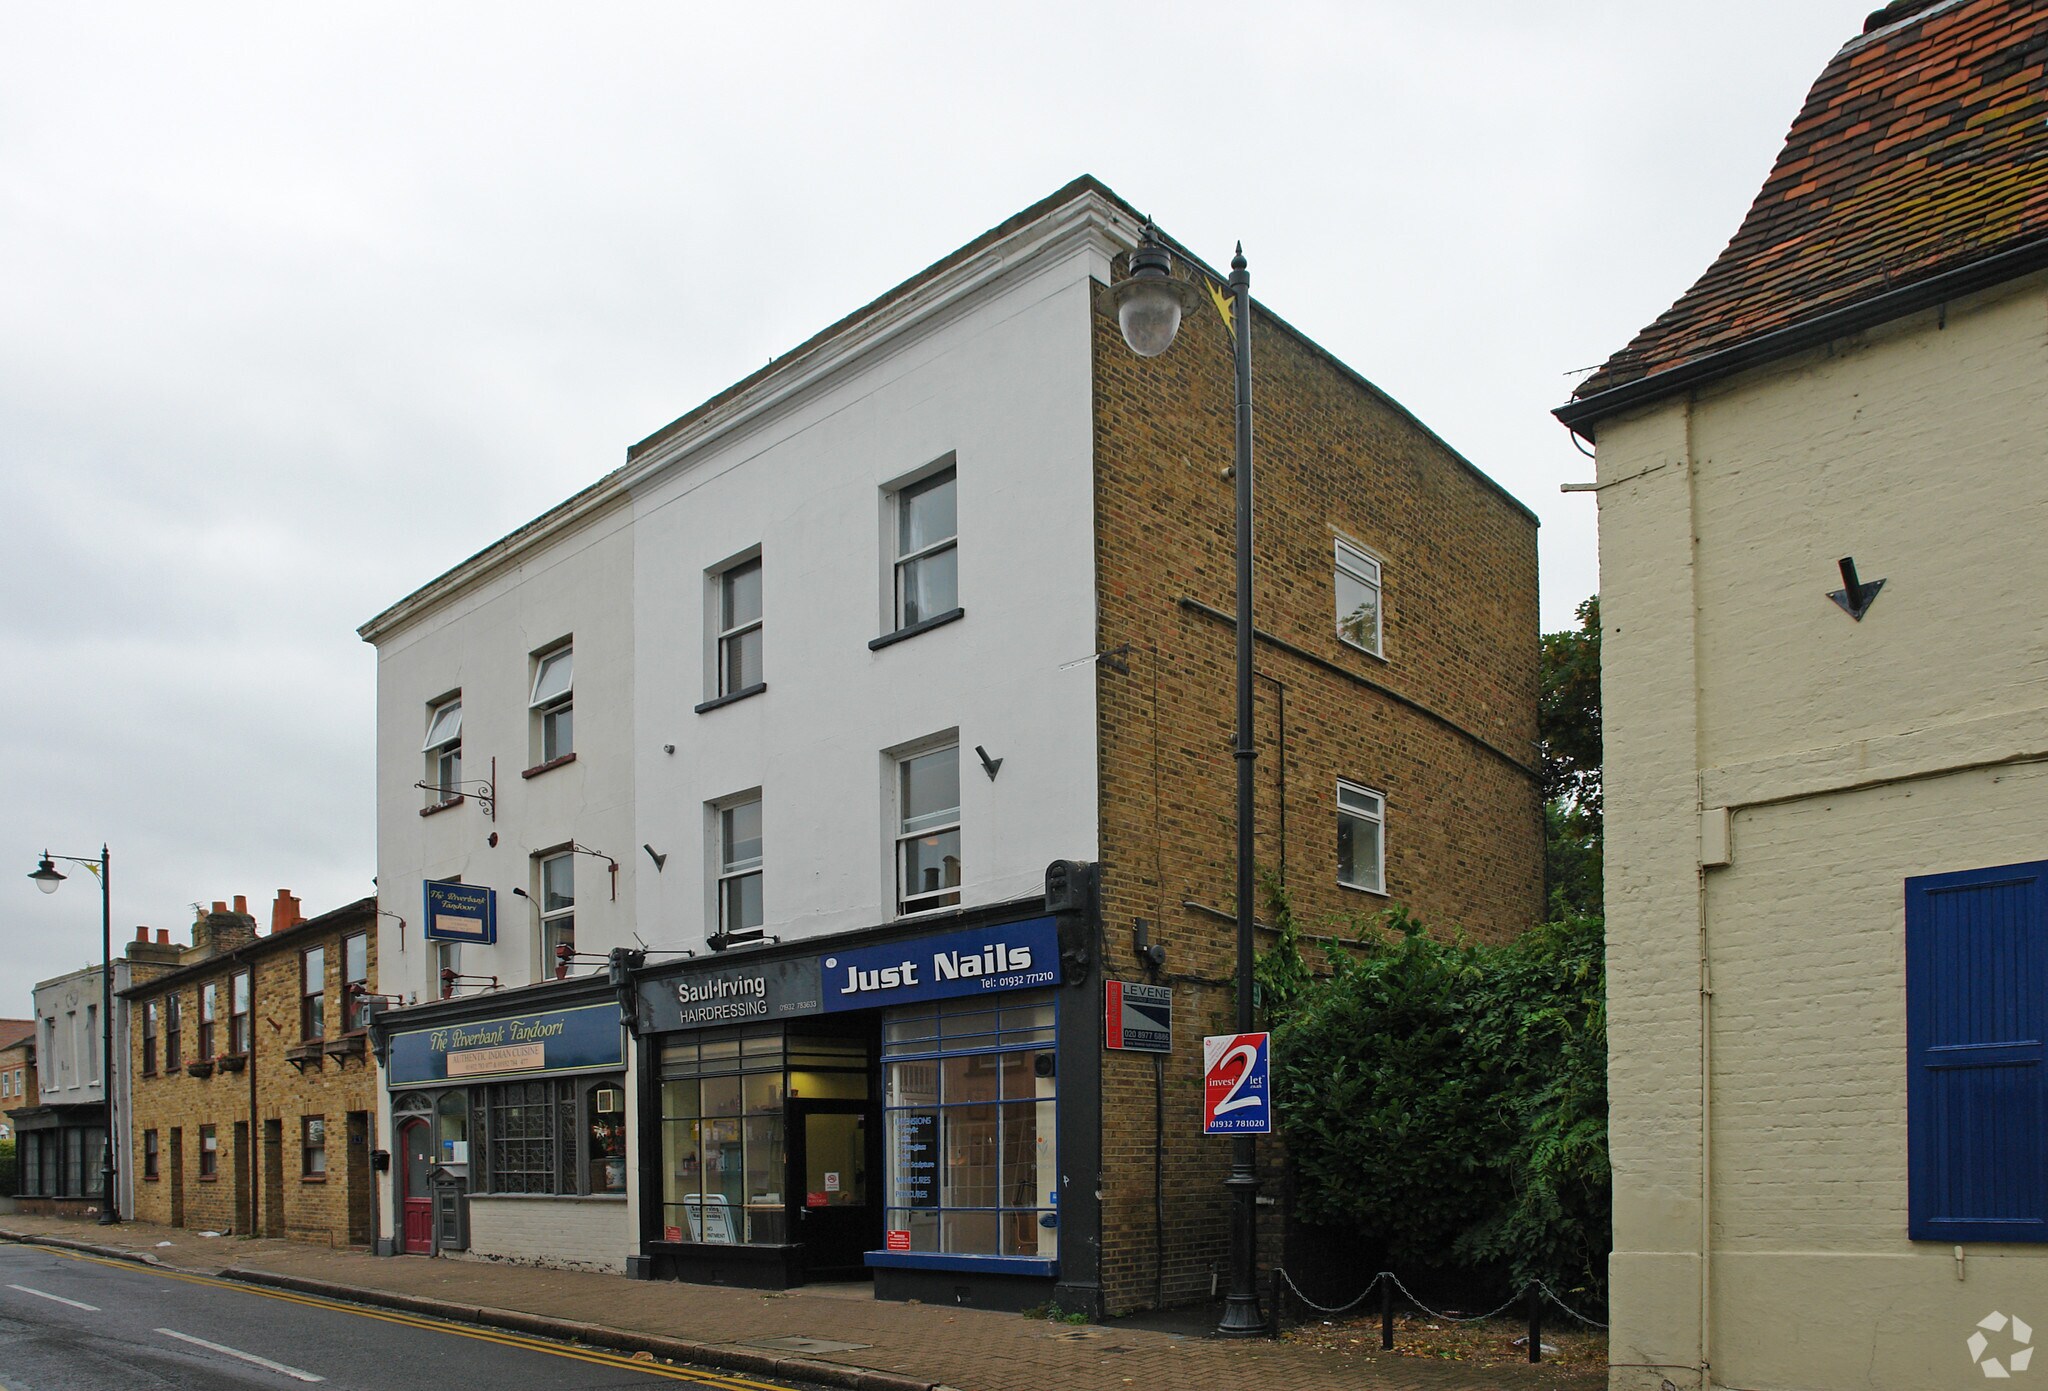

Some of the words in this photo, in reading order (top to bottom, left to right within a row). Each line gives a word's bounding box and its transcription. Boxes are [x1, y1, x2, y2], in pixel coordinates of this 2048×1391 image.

[430, 890, 444, 899] The
[841, 960, 918, 994] Just
[933, 943, 1032, 981] Nails
[980, 978, 997, 989] Tel:
[999, 975, 1023, 987] 01932
[1026, 971, 1054, 984] 771210
[1123, 985, 1171, 999] LEVENE
[680, 1000, 767, 1023] HAIRDRESSING
[430, 1030, 448, 1052] The
[452, 1025, 505, 1047] Riverbank
[509, 1018, 565, 1041] Tandoori
[1124, 1029, 1136, 1038] 020
[452, 1051, 487, 1063] AUTHENTIC
[488, 1049, 512, 1060] INDIAN
[512, 1046, 539, 1057] CUISINE
[1209, 1078, 1235, 1087] invest
[1213, 1044, 1262, 1116] 2
[1249, 1075, 1262, 1085] let
[1209, 1120, 1233, 1128] 01932
[1235, 1119, 1265, 1128] 781020
